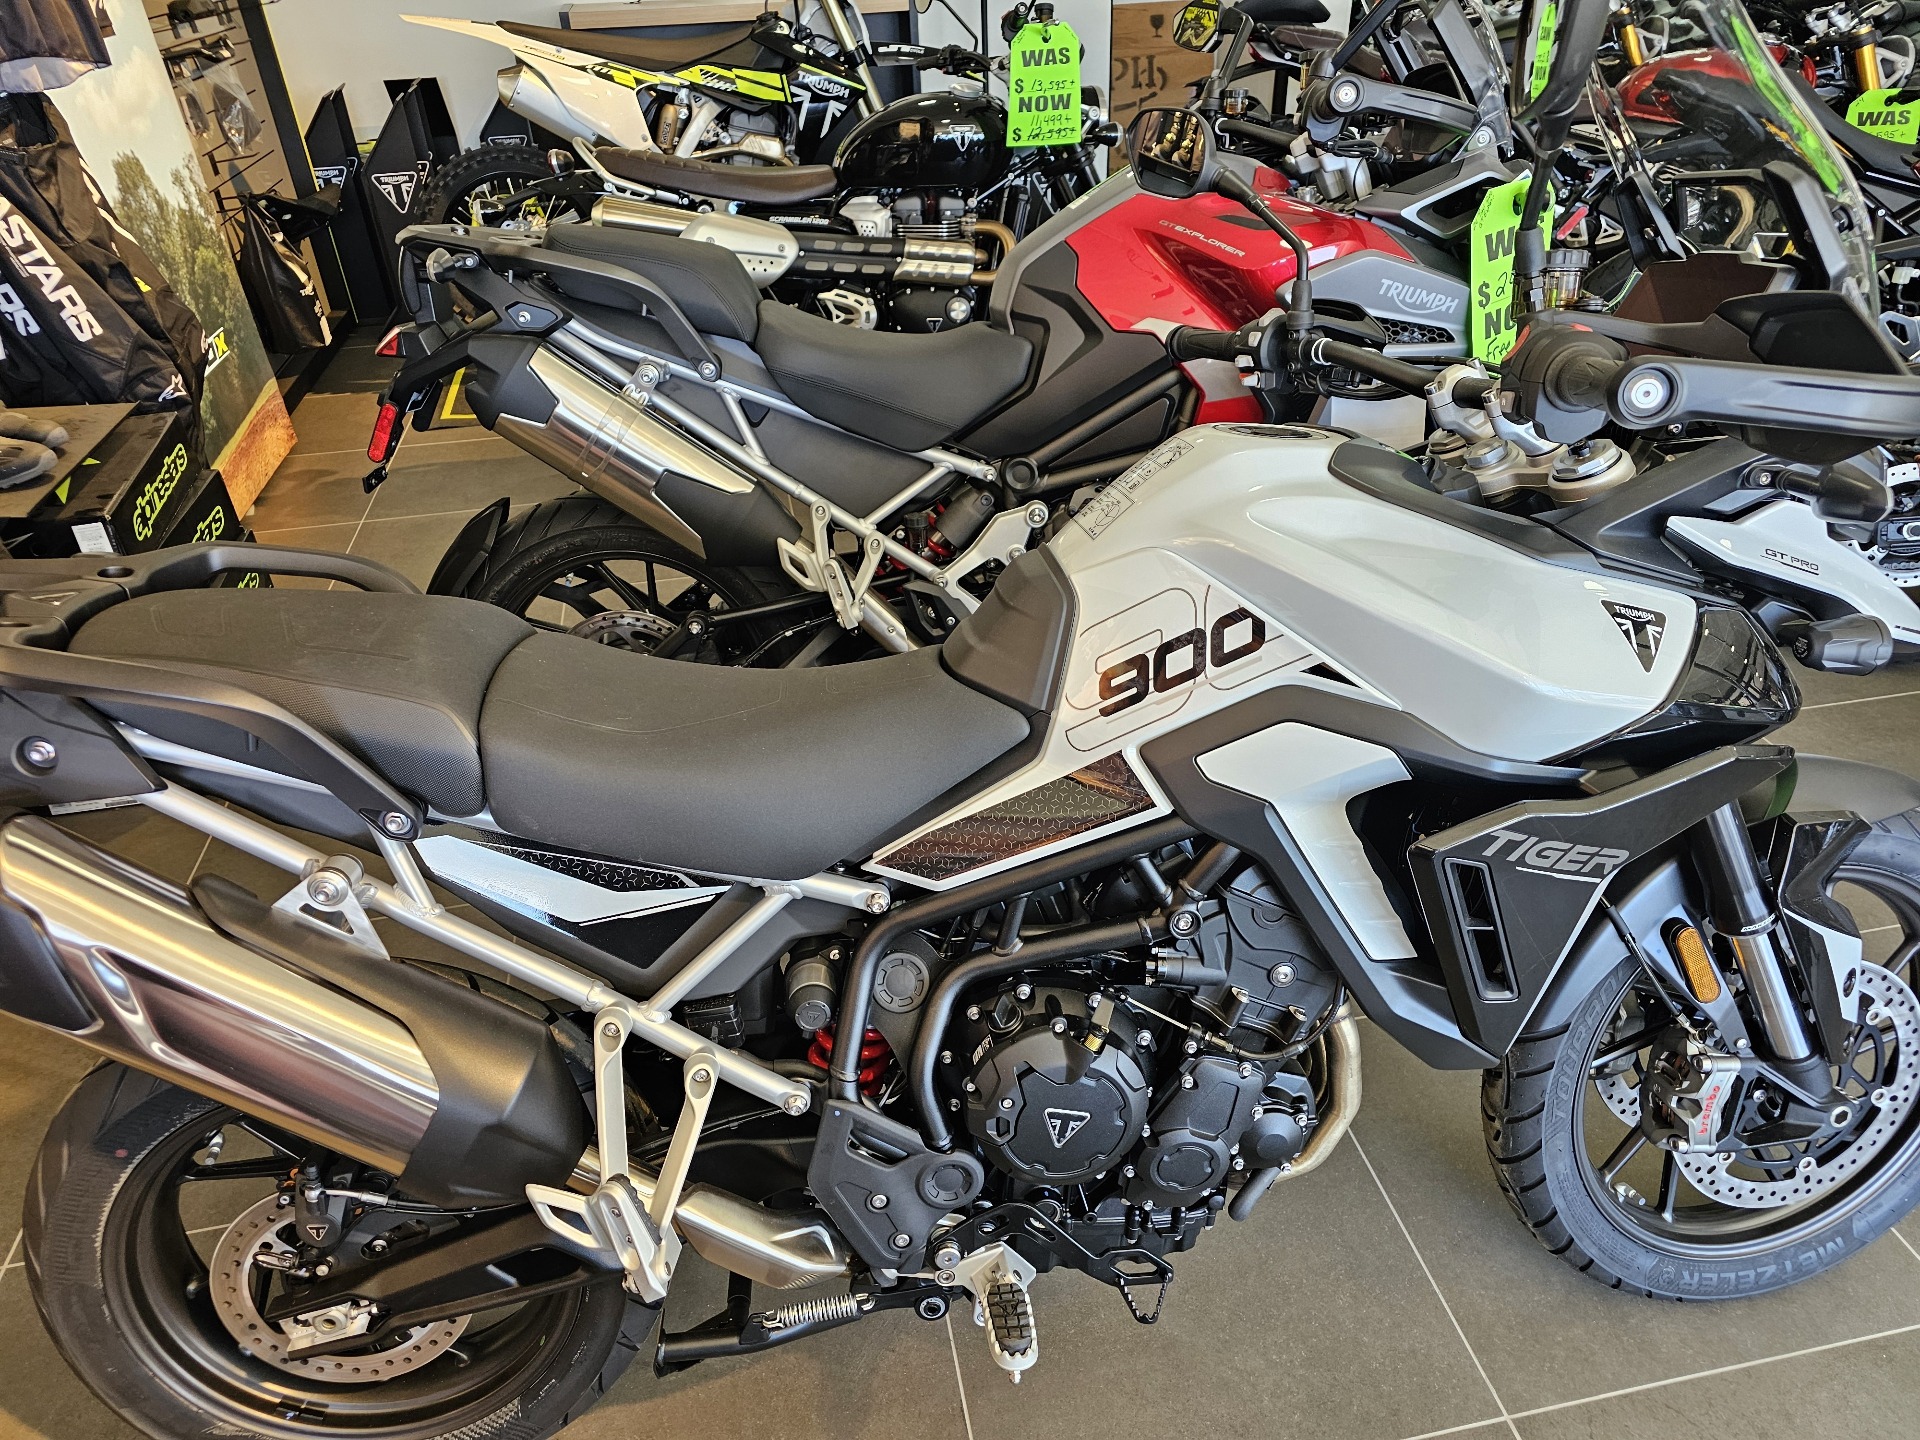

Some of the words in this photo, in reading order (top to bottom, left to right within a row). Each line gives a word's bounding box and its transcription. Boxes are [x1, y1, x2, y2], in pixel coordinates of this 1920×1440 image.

[1021, 47, 1070, 67] WAS
[797, 71, 850, 99] TRIUMPH
[1015, 78, 1024, 94] $
[1018, 93, 1072, 113] NOW
[1857, 110, 1912, 126] WAS
[1012, 127, 1021, 142] $
[0, 196, 104, 342] STARS
[1379, 278, 1459, 314] TRIUMPH
[1478, 281, 1491, 309] $
[1765, 548, 1788, 560] GT
[1790, 556, 1819, 571] PRO
[1613, 604, 1656, 622] TRIUMPH
[1099, 606, 1266, 718] 900
[1482, 829, 1630, 875] TIGER
[1697, 1085, 1721, 1136] brembo
[1679, 1236, 1846, 1291] METZELER
